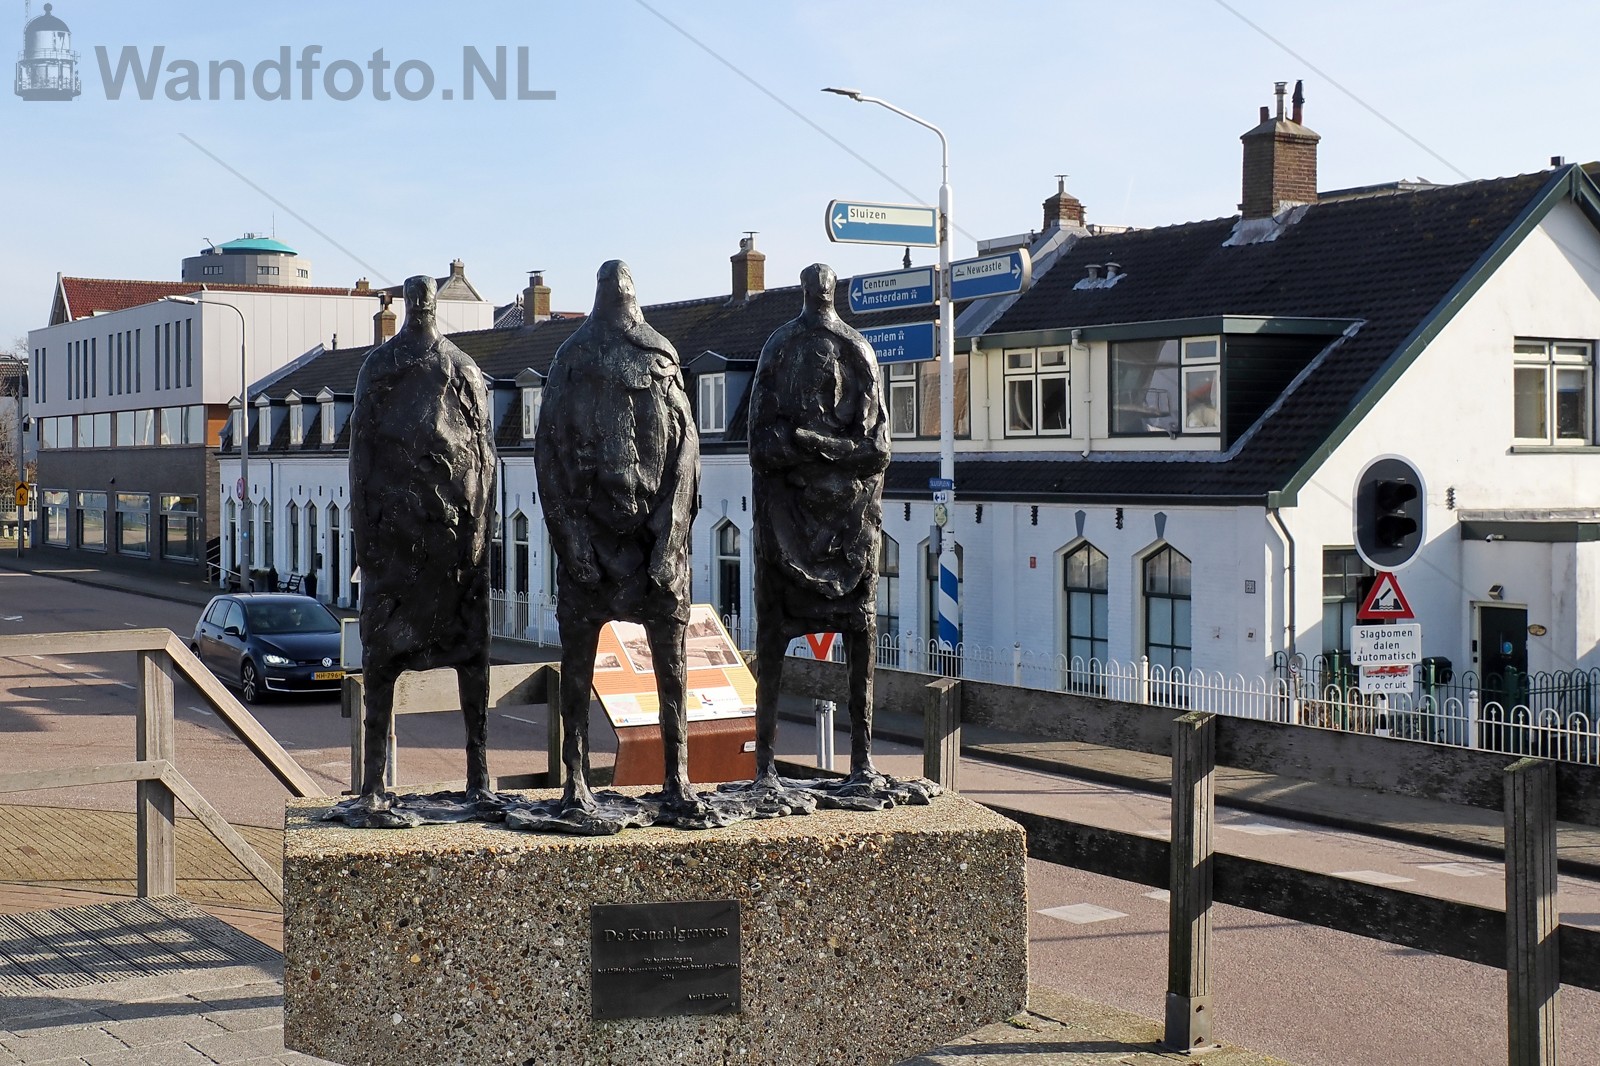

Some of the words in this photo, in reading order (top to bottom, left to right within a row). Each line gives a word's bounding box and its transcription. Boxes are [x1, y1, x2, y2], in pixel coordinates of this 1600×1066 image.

[849, 208, 887, 220] Sluizen
[966, 260, 1002, 276] Newcastle
[863, 277, 897, 290] Centrum
[862, 289, 909, 305] Amsterdam
[19, 492, 25, 501] K
[1360, 629, 1413, 641] Slagbomen
[1373, 641, 1400, 650] dalen
[1357, 651, 1417, 662] automatisch
[604, 928, 625, 942] De
[627, 925, 729, 943] Kanaalgravers
